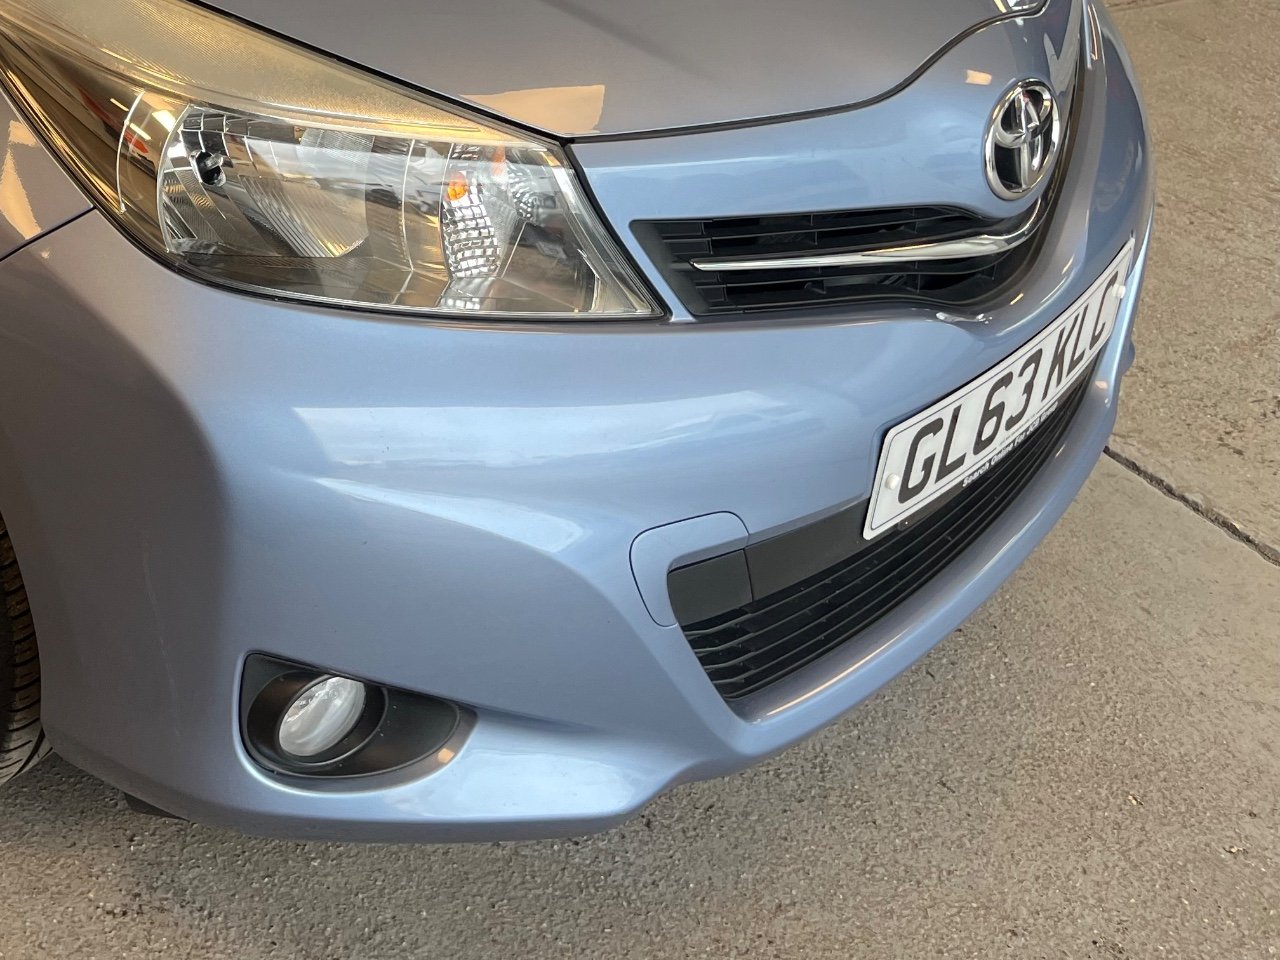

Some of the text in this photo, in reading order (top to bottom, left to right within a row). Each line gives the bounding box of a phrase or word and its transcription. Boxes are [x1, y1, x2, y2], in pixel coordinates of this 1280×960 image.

[897, 271, 1119, 504] GL63 KLC
[962, 462, 990, 487] Search
